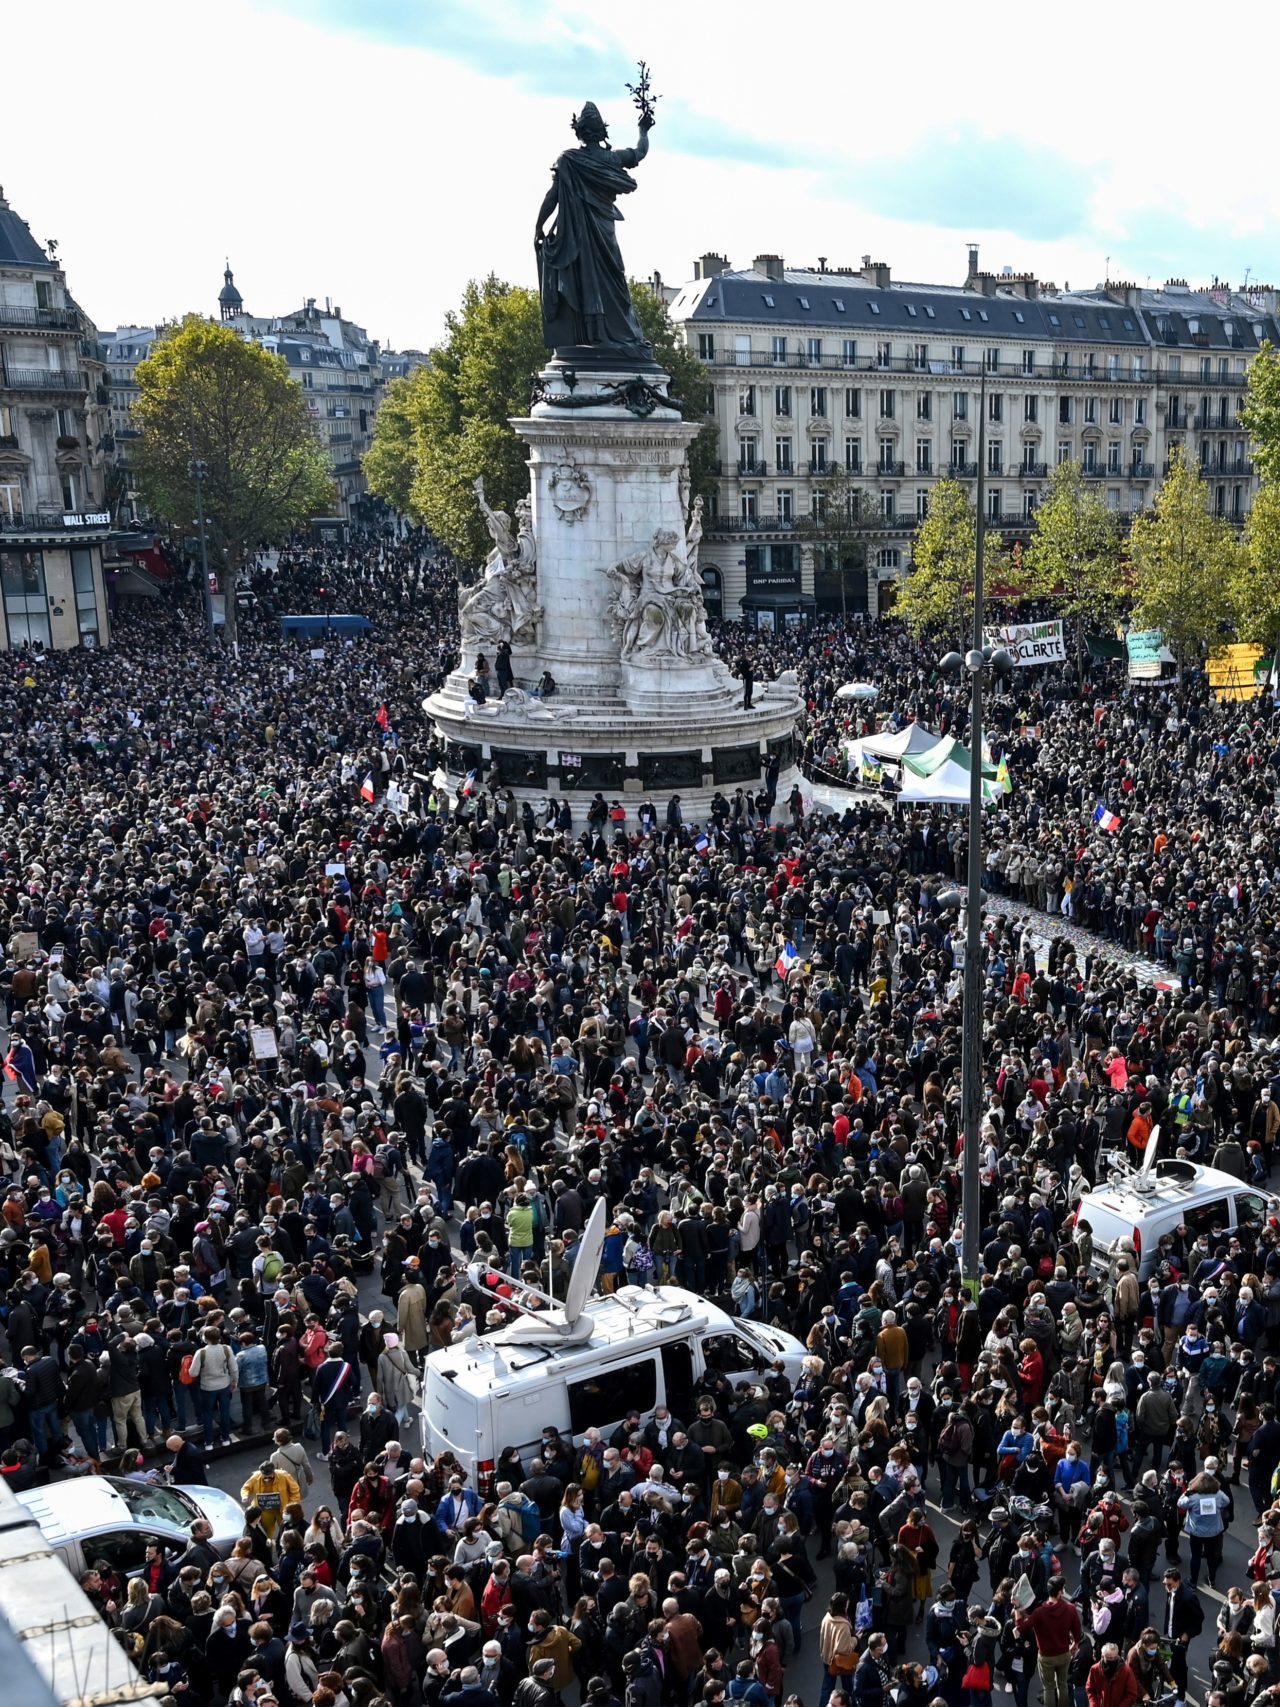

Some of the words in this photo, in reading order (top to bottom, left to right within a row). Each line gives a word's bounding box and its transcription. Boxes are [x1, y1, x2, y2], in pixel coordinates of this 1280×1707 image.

[63, 514, 84, 526] WALL
[85, 511, 111, 525] STREET
[1019, 638, 1062, 658] CLARTÉ
